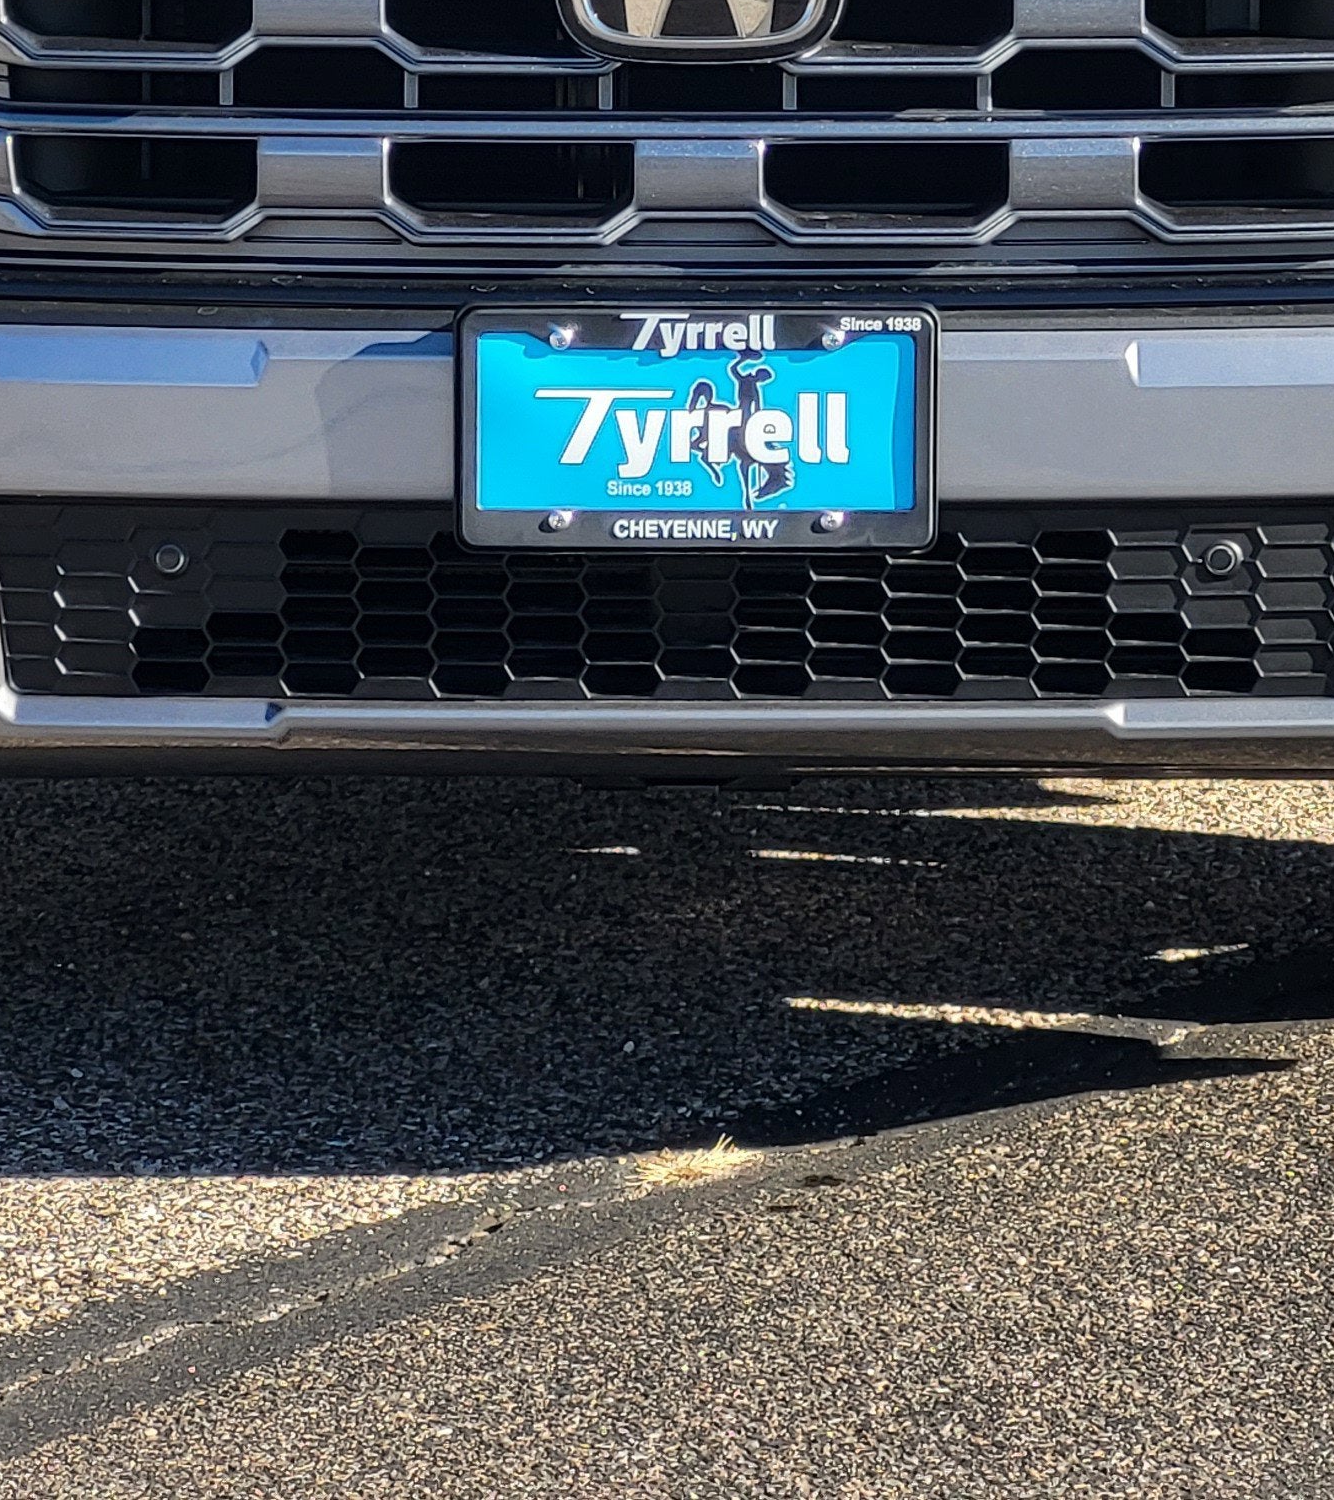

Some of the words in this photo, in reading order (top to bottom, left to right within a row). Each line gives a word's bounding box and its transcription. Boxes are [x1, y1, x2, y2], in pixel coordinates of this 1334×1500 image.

[619, 312, 776, 357] Tyrrell
[839, 316, 883, 332] Since
[885, 316, 922, 332] 1938
[534, 388, 850, 479] Tyrrell
[607, 480, 652, 496] Since
[654, 480, 692, 496] 1938
[613, 518, 737, 542] CHEYENNE,
[741, 518, 779, 539] WY
